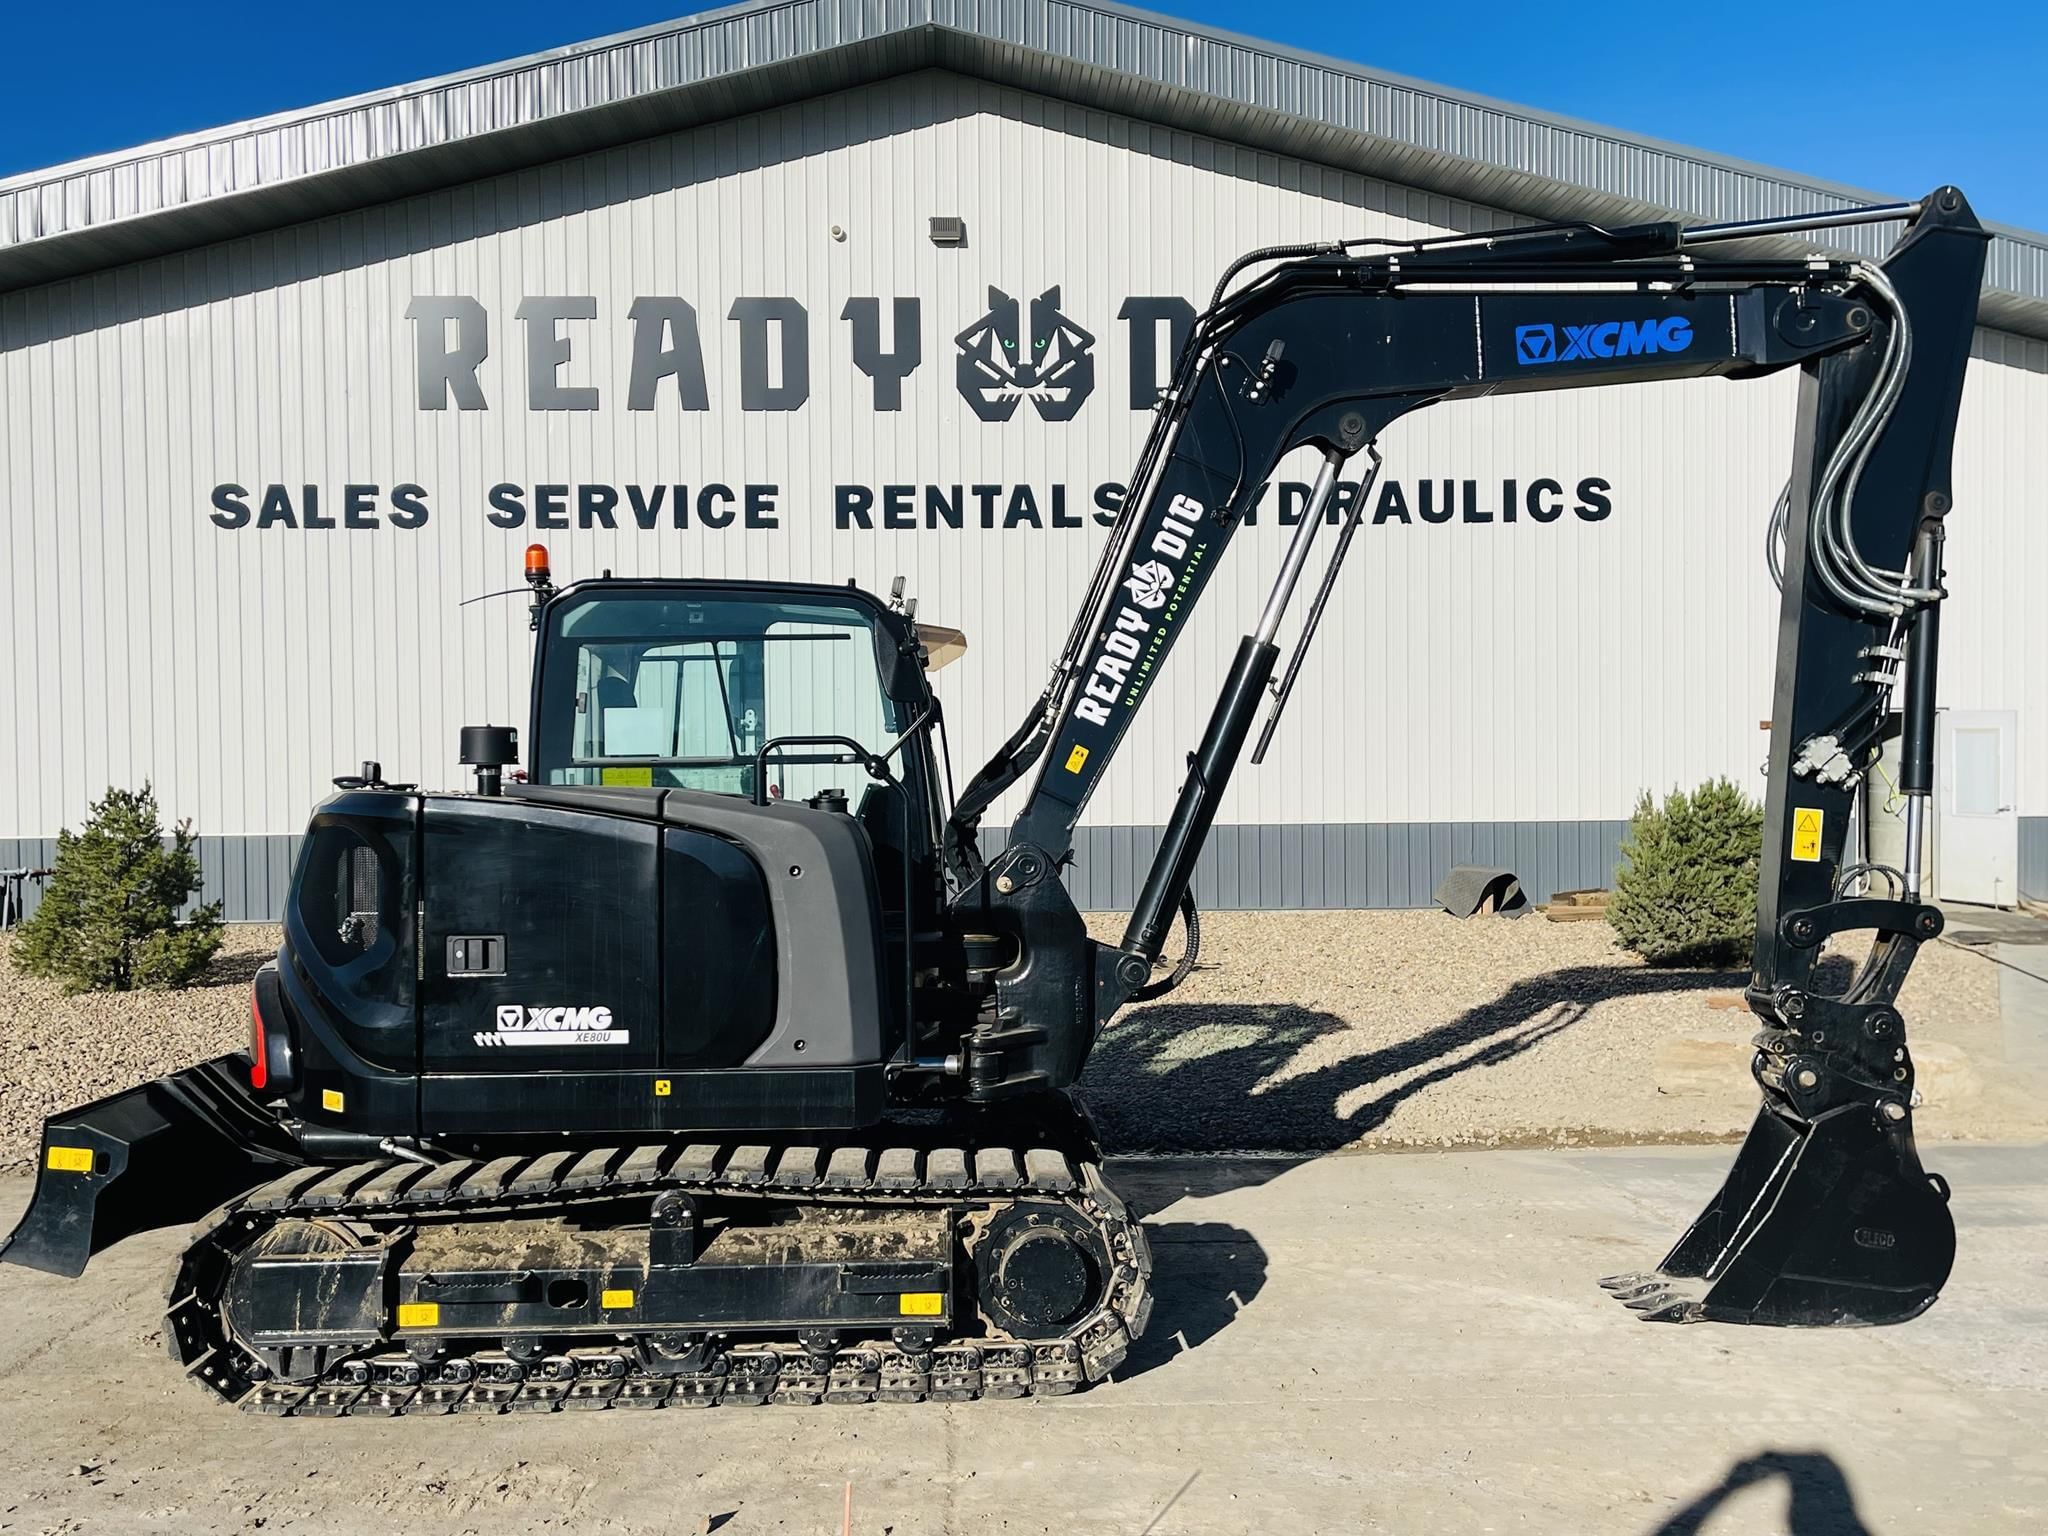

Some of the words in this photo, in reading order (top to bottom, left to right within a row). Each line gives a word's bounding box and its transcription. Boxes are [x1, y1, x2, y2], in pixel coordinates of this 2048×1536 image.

[404, 295, 921, 411] READY
[1556, 316, 1694, 362] XCMG
[208, 483, 430, 530] SALES
[486, 482, 779, 530] SERVICE
[834, 481, 1130, 529] RENTALS
[1243, 477, 1613, 526] YDRAULICS
[1073, 605, 1151, 727] READY
[1150, 493, 1205, 560] DIG
[1125, 626, 1167, 706] UNLIMITED
[1164, 541, 1207, 621] POTENTIAL
[522, 1006, 613, 1031] XCMG
[574, 1032, 612, 1043] XE80U
